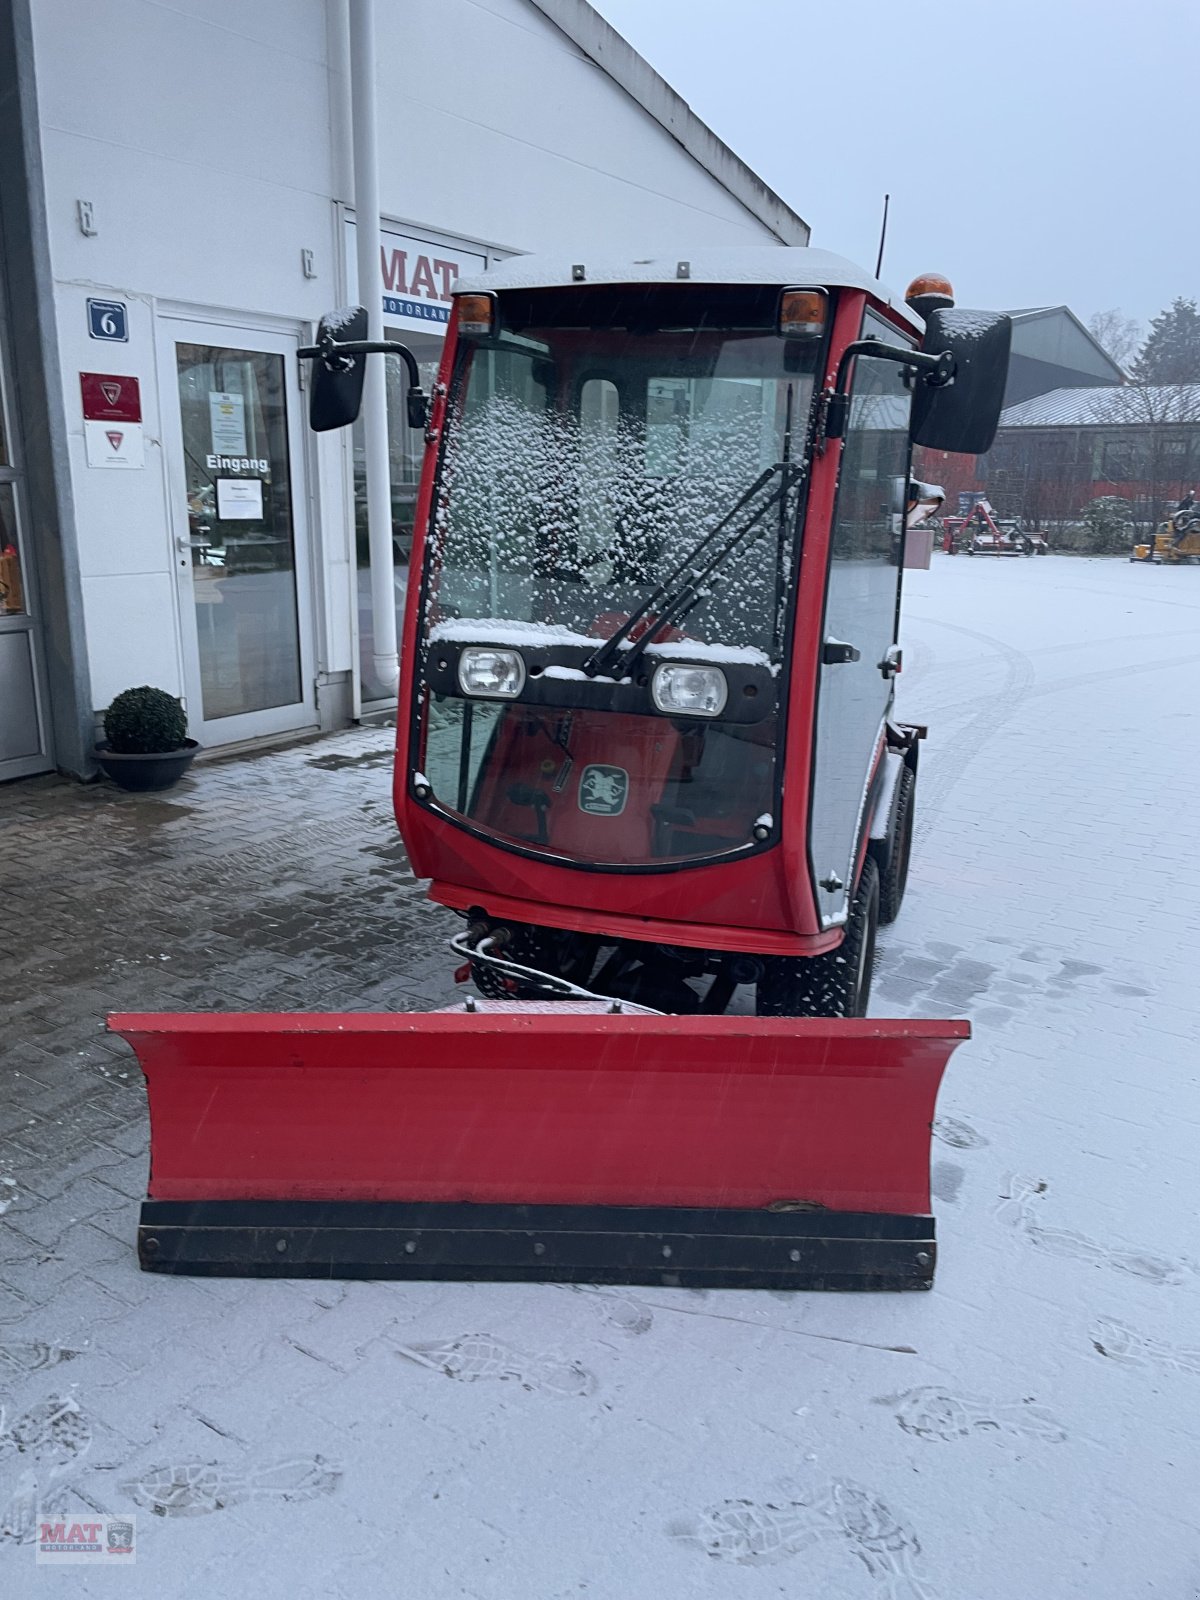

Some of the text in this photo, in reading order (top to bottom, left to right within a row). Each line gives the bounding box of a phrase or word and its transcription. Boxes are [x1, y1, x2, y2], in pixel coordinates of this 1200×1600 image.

[380, 245, 459, 302] MAT
[383, 299, 450, 321] OTORLAN
[101, 312, 117, 335] 6
[206, 454, 269, 472] Eingang
